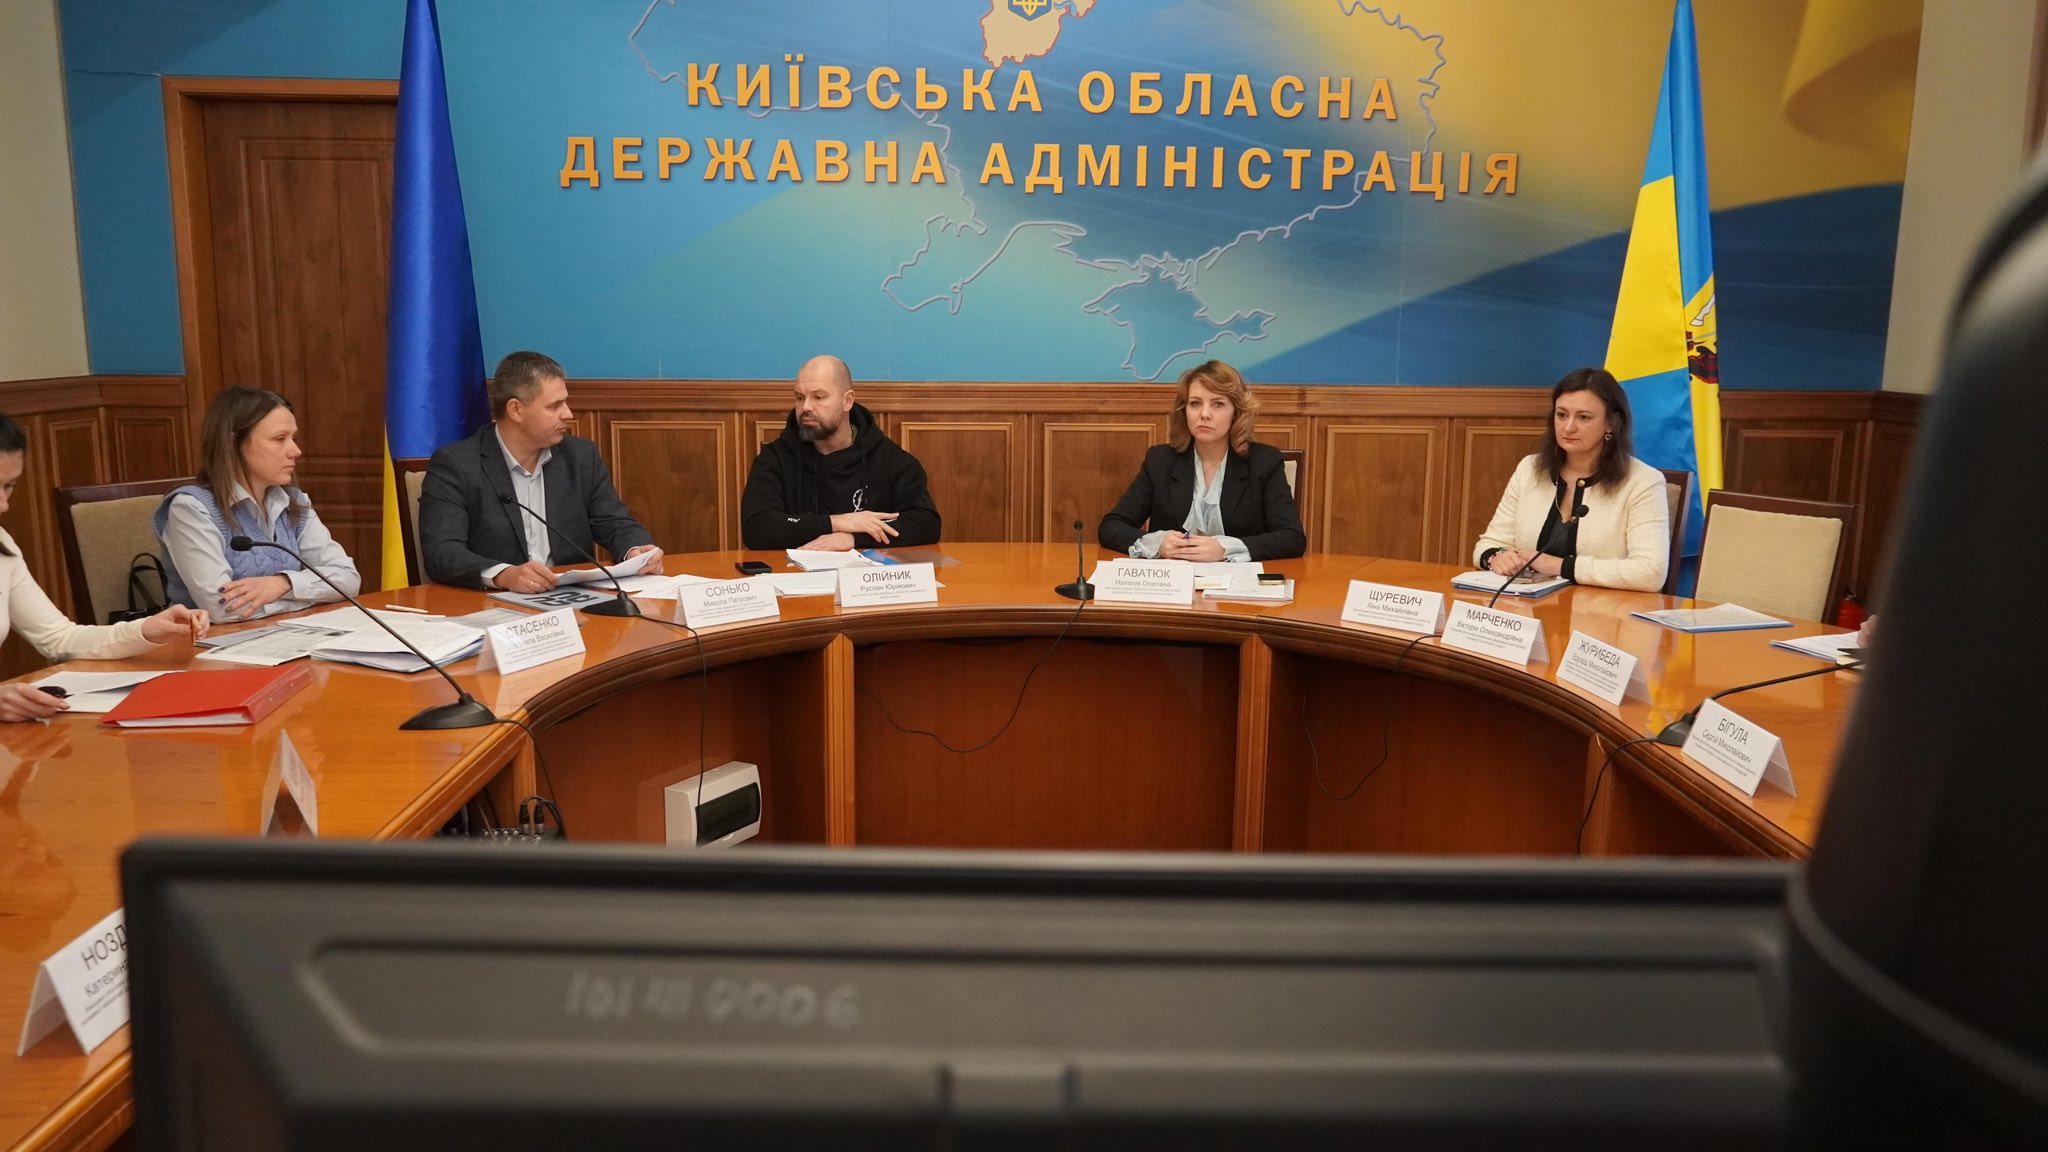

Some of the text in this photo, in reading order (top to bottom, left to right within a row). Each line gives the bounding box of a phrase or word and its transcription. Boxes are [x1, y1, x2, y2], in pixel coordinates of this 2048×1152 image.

[686, 54, 1399, 122] КИЇВСЬКА ОБЛАСНА
[559, 135, 1521, 200] ДЕРЖАВНА АДМІНІСТРАЦІЯ
[862, 570, 912, 583] ОЛІЙНИК
[1117, 567, 1171, 578] ГАВАТЮК
[705, 582, 750, 598] СОНЬКО
[1368, 590, 1423, 607] ЩУРЕВИЧ
[1466, 609, 1522, 632] МАРЧЕНКО
[1579, 640, 1621, 668] ЖУРИБЕДА
[1717, 718, 1749, 745] БІГУЛА
